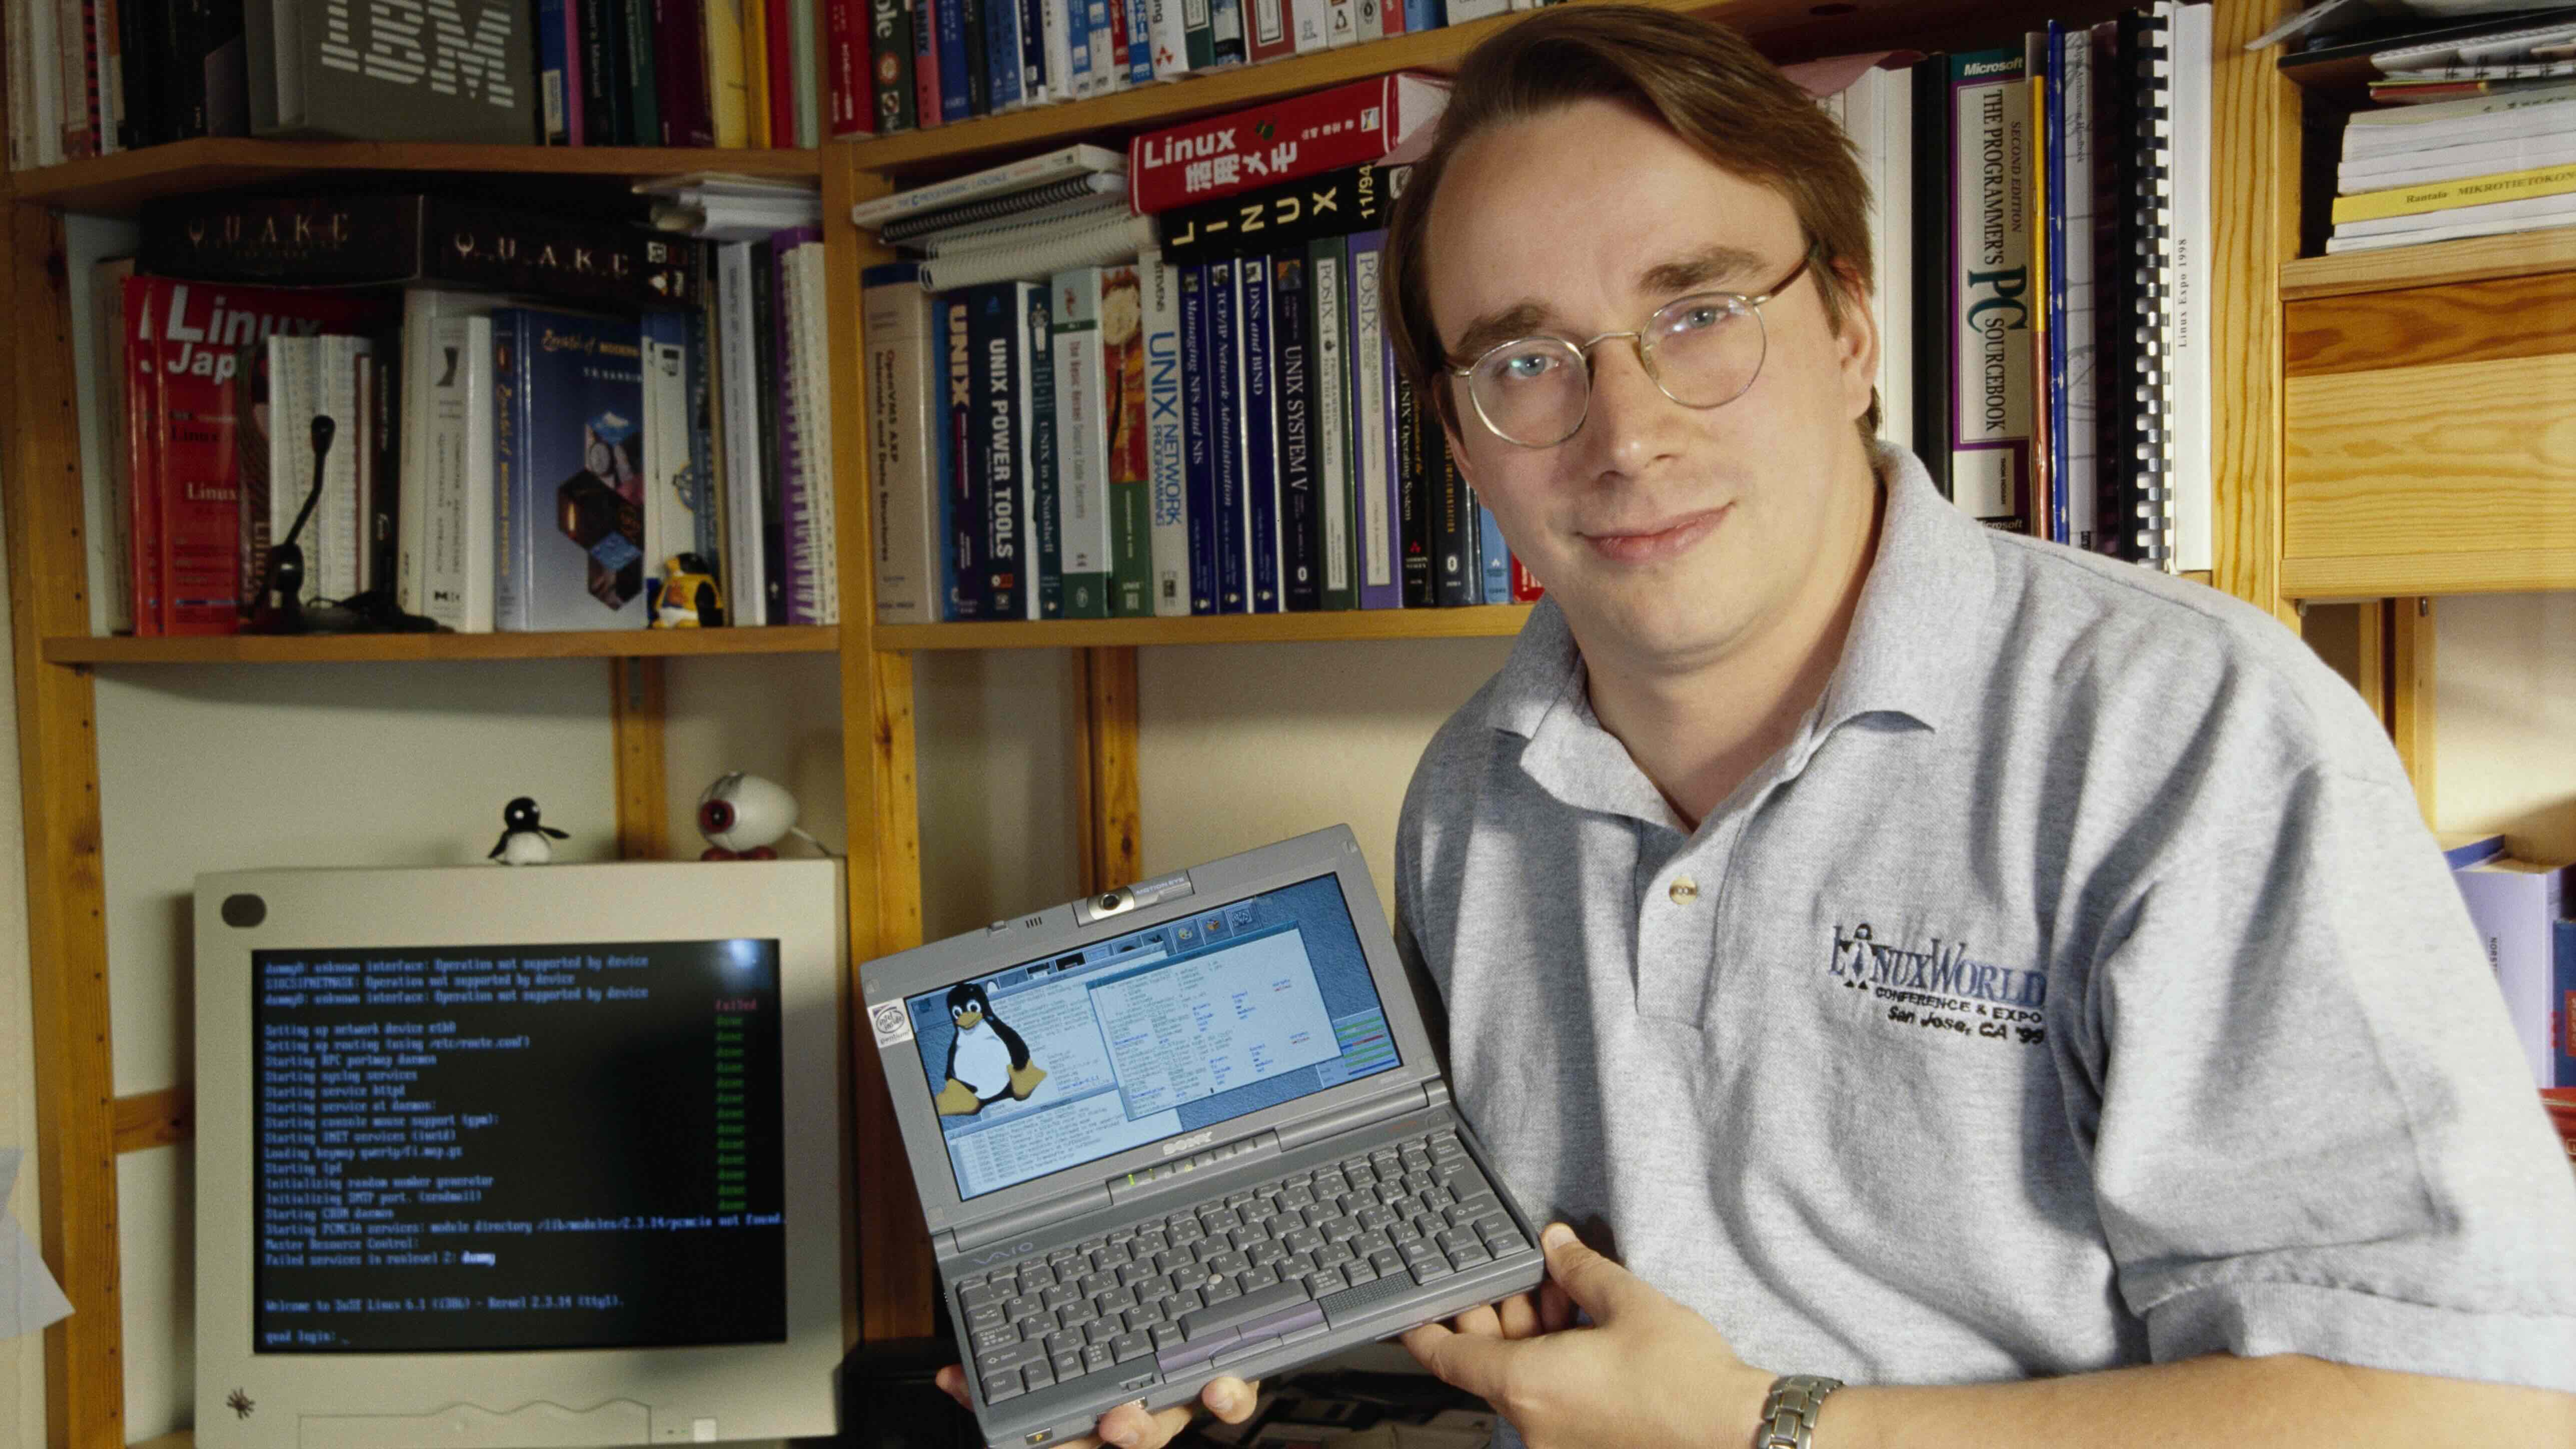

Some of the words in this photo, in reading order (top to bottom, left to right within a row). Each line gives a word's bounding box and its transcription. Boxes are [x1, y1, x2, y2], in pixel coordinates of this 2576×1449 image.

[321, 0, 515, 109] IBM
[1962, 63, 2024, 76] Microsoft
[1982, 89, 2003, 125] THE
[2076, 71, 2085, 118] Architecture
[1144, 128, 1237, 169] Linux
[2010, 121, 2021, 169] SECOND
[1171, 186, 1338, 246] LINUX
[1359, 165, 1375, 219] 11/94
[1982, 128, 2004, 265] PROGRAMMER'S
[2011, 171, 2022, 232] EDITION
[2177, 238, 2188, 266] 1998
[1247, 287, 1260, 319] DNS
[1967, 266, 2028, 333] PC
[2176, 273, 2188, 305] Expo
[166, 284, 324, 348] Linux
[1184, 298, 1199, 371] Managing
[1216, 292, 1228, 338] TCP/IP
[1249, 322, 1263, 352] and
[2177, 311, 2188, 349] Linux
[947, 304, 970, 408] UNIX
[988, 339, 1008, 393] UNIX
[1148, 331, 1177, 421] UNIX
[1217, 341, 1230, 399] Network
[1251, 356, 1264, 395] BIND
[1283, 345, 1303, 395] UNIX
[1984, 319, 2006, 430] SOURCEBOOK
[1190, 376, 1201, 403] NFS
[877, 420, 886, 446] and
[990, 401, 1011, 481] POWER
[1191, 406, 1203, 436] and
[1286, 400, 1305, 473] SYSTEM
[1040, 464, 1051, 478] in
[1153, 424, 1167, 527] PROGRAMMING
[1164, 424, 1181, 527] NETWORK
[1191, 440, 1203, 465] NIS
[1220, 404, 1234, 507] Administration
[1400, 424, 1413, 479] Operating
[1290, 476, 1308, 492] V
[1401, 481, 1413, 521] System
[993, 487, 1013, 559] TOOLS
[1876, 986, 1971, 1013] CONFERENCE
[1977, 1005, 1987, 1015] &
[1992, 1007, 2042, 1024] EXPO
[1887, 1006, 1916, 1024] San
[1979, 1022, 2007, 1039] CA
[1163, 1131, 1213, 1156] SONY
